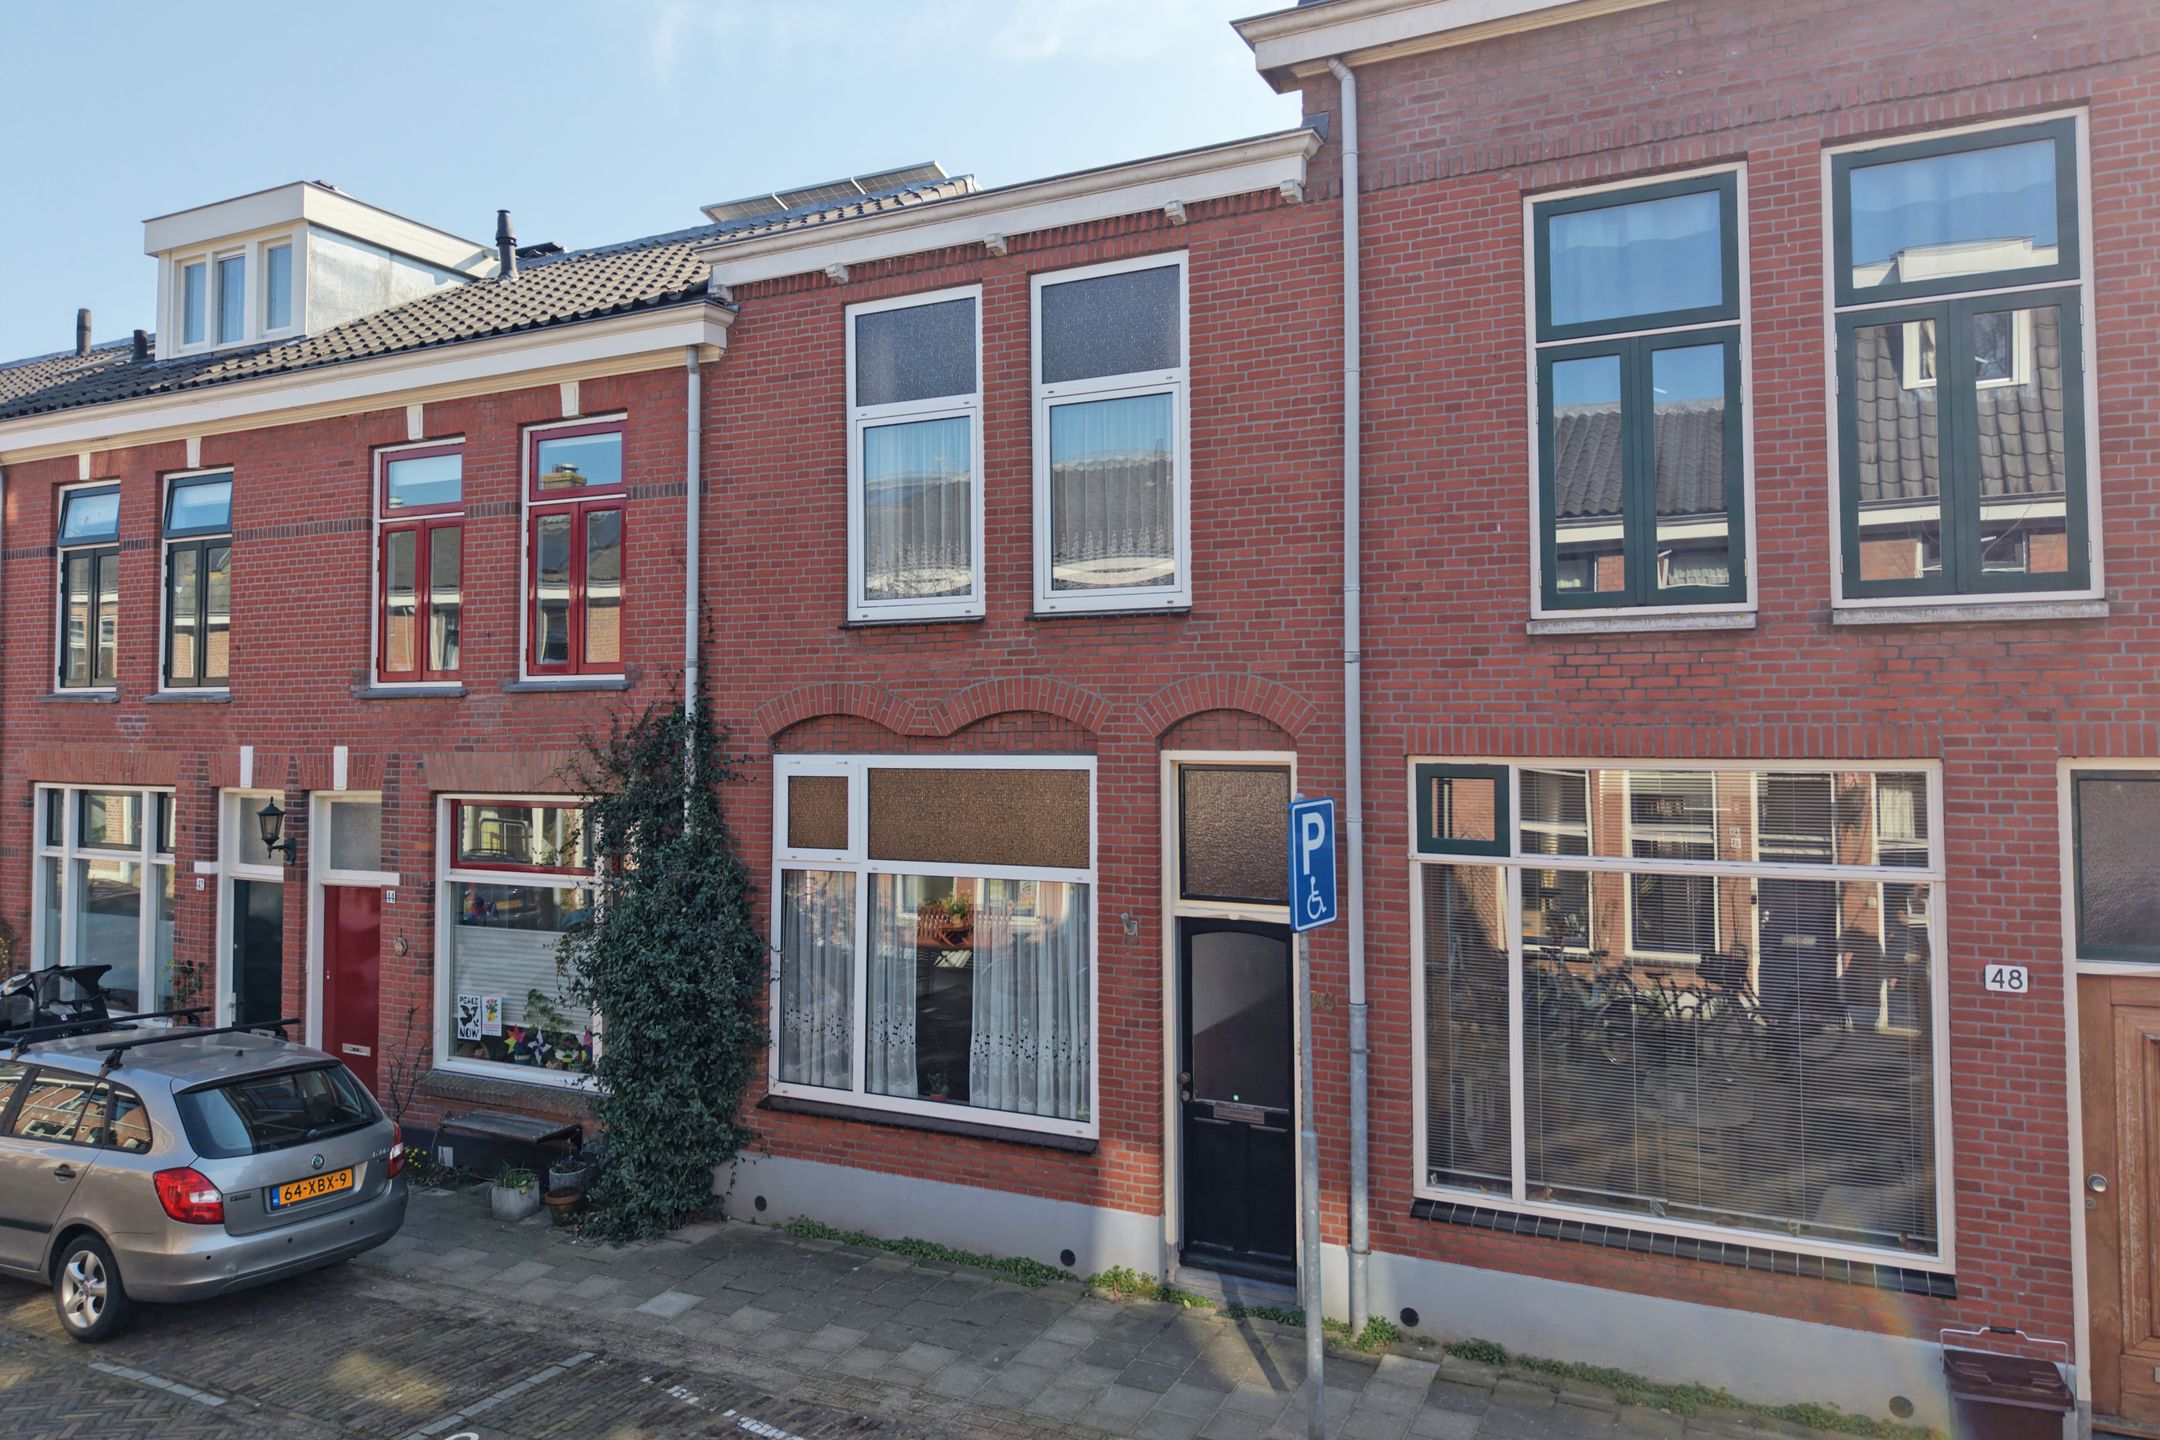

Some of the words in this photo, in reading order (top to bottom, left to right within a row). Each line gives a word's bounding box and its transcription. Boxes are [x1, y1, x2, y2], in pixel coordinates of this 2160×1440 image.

[1302, 812, 1325, 875] P
[1991, 968, 2023, 990] 48
[459, 995, 479, 1006] PEACE
[460, 1028, 479, 1038] NOW
[284, 1173, 347, 1201] 64-XBX-9
